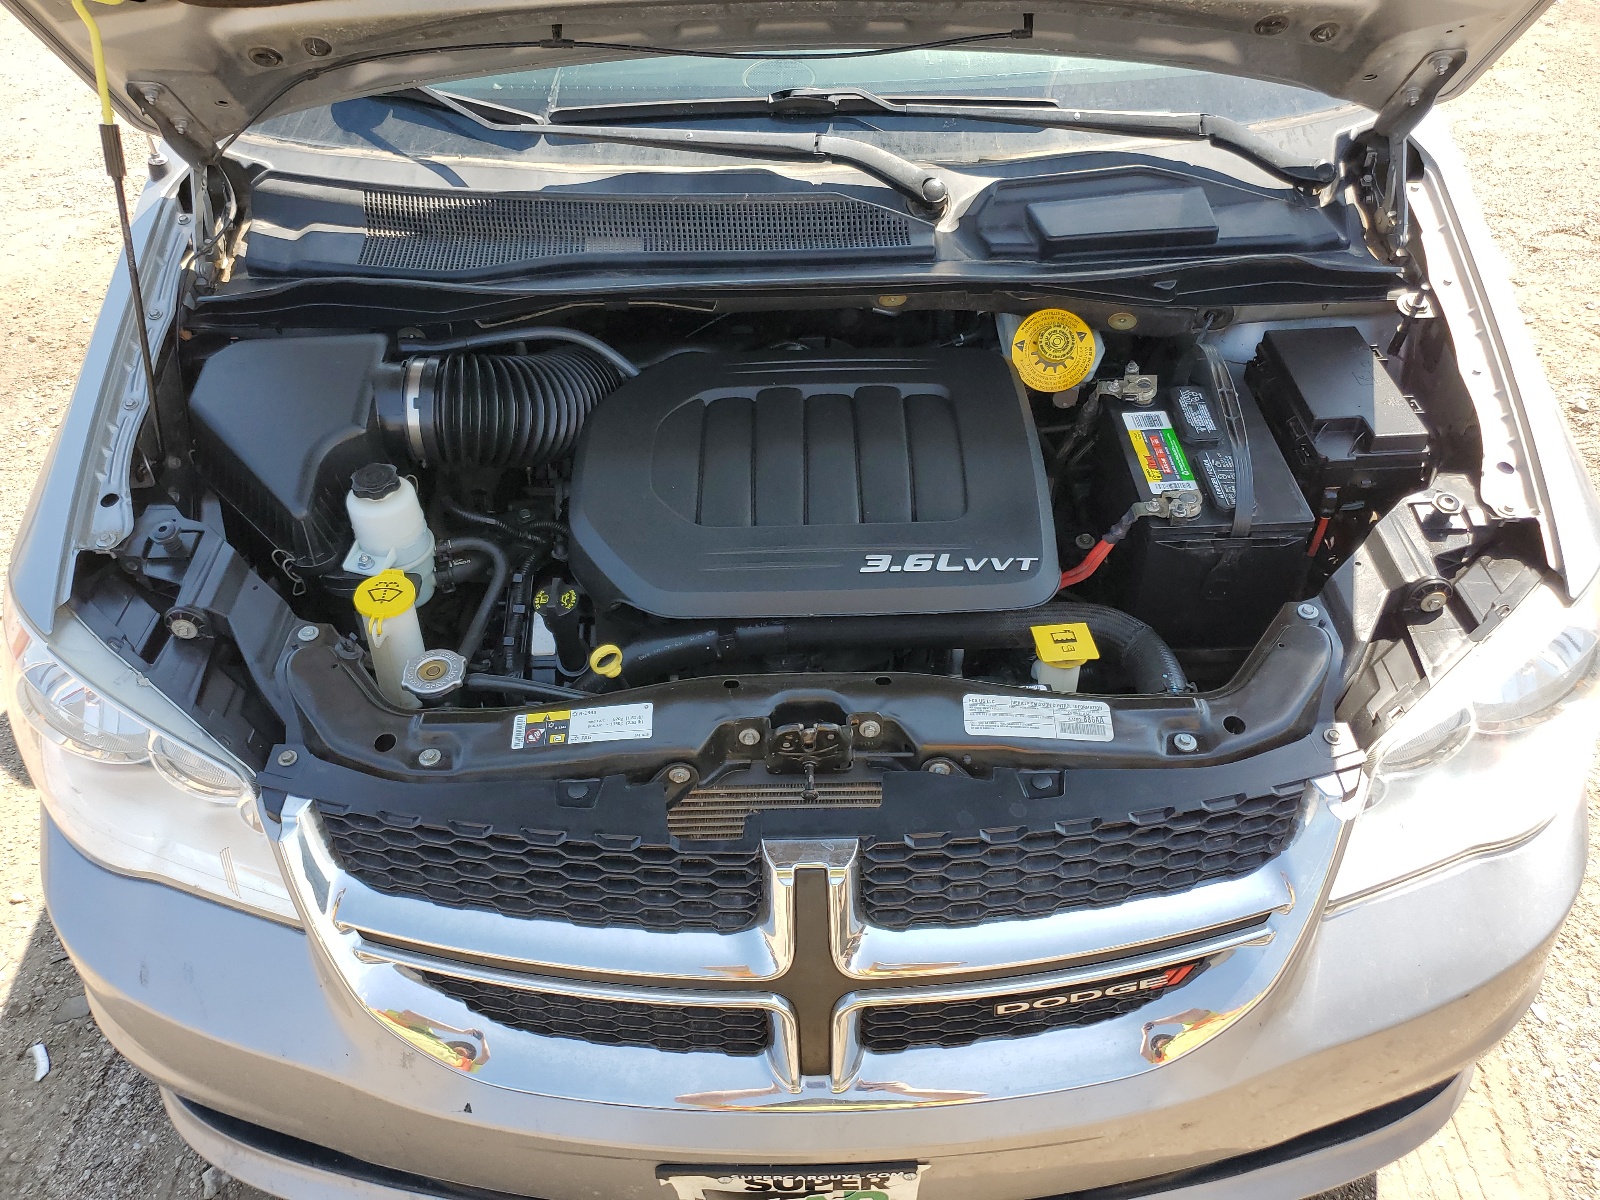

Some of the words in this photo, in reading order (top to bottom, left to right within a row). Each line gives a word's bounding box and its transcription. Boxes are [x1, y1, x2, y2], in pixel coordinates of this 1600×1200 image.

[996, 974, 1169, 1015] DODGE
[730, 1171, 904, 1182] SUPERCARGUYS.COM
[744, 1176, 891, 1191] SUPER
